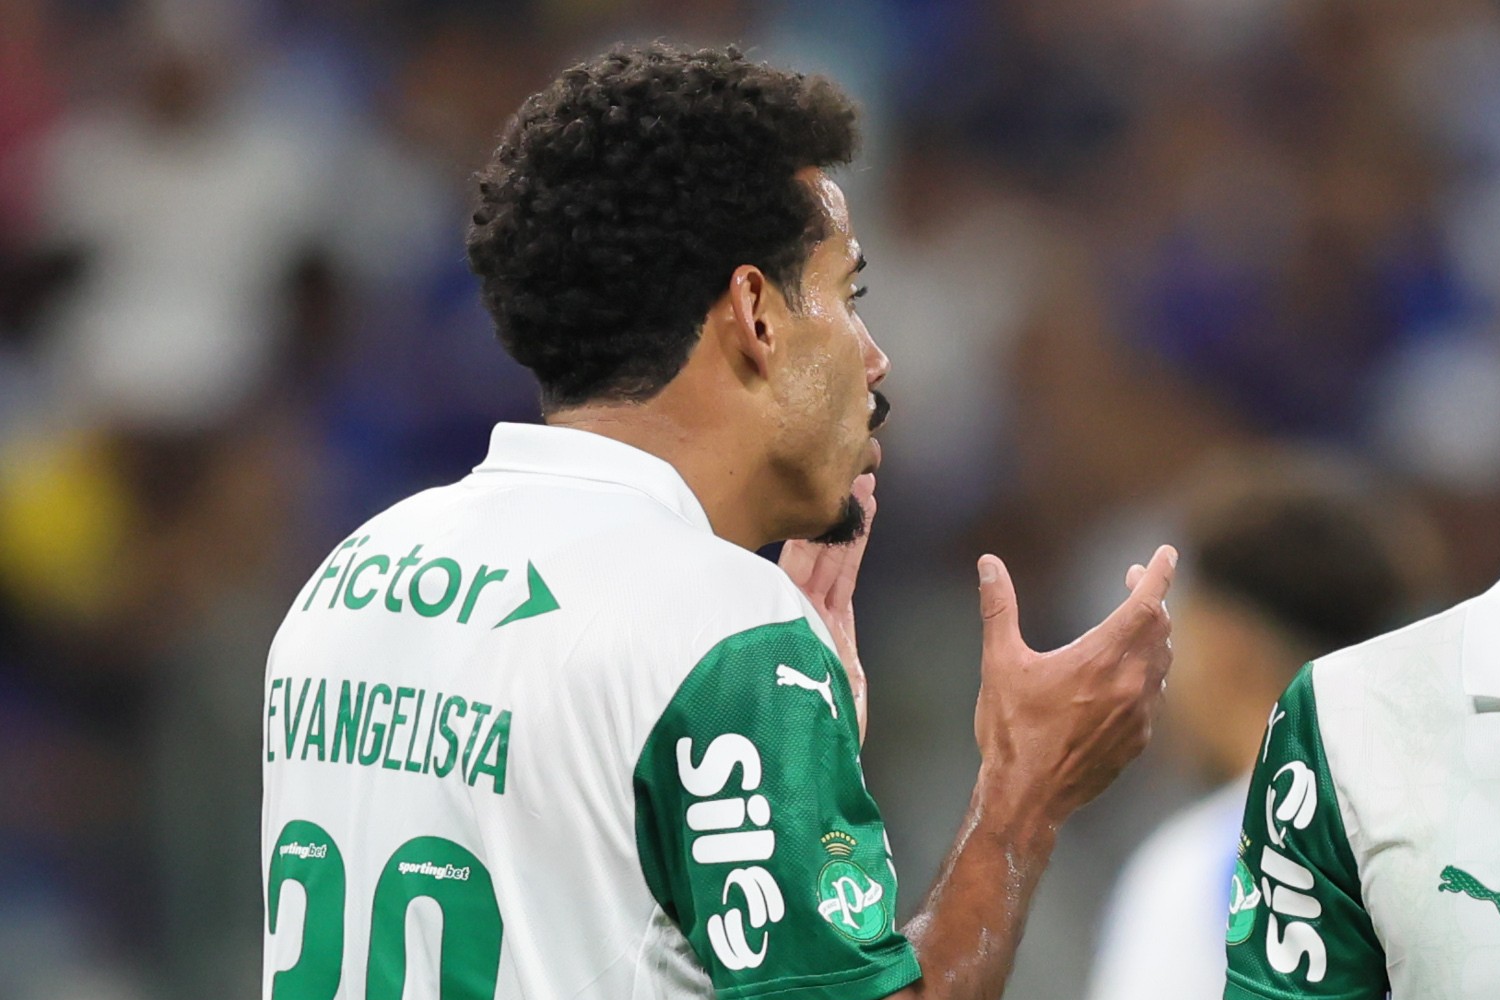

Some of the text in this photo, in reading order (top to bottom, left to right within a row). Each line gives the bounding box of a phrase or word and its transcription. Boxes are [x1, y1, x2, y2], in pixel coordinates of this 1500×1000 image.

[302, 535, 509, 624] Fictor
[267, 677, 512, 795] EVANGELISTA
[398, 861, 470, 881] sportingbet
